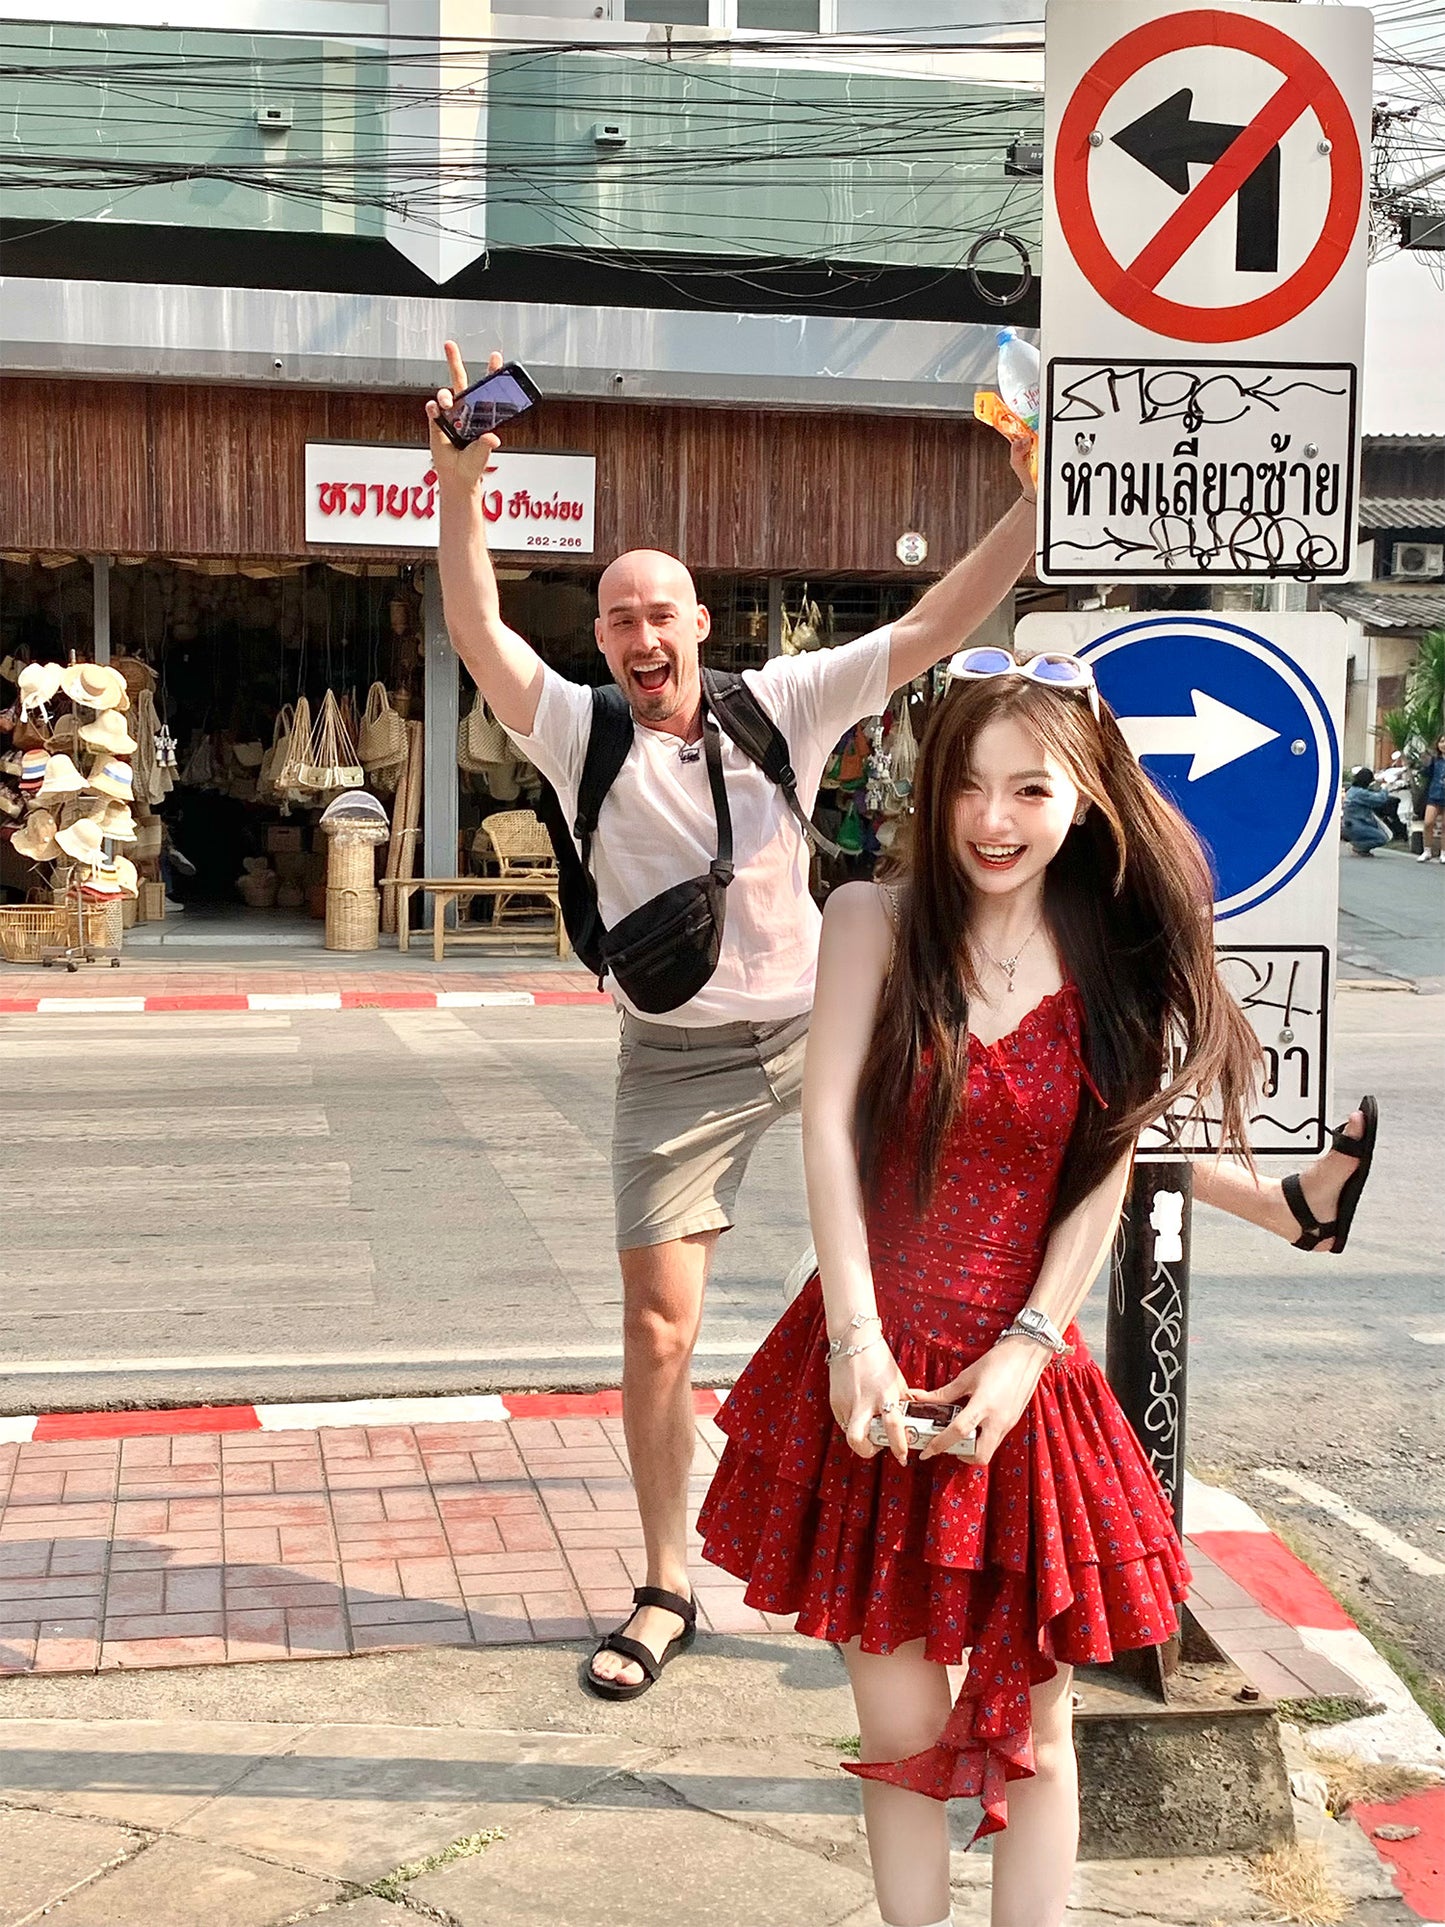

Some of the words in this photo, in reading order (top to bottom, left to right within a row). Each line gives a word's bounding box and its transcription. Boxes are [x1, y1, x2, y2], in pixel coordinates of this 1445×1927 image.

[1061, 414, 1340, 516] ห้ามเลี้ยวซ้าย
[508, 490, 583, 520] ช้างม่อย
